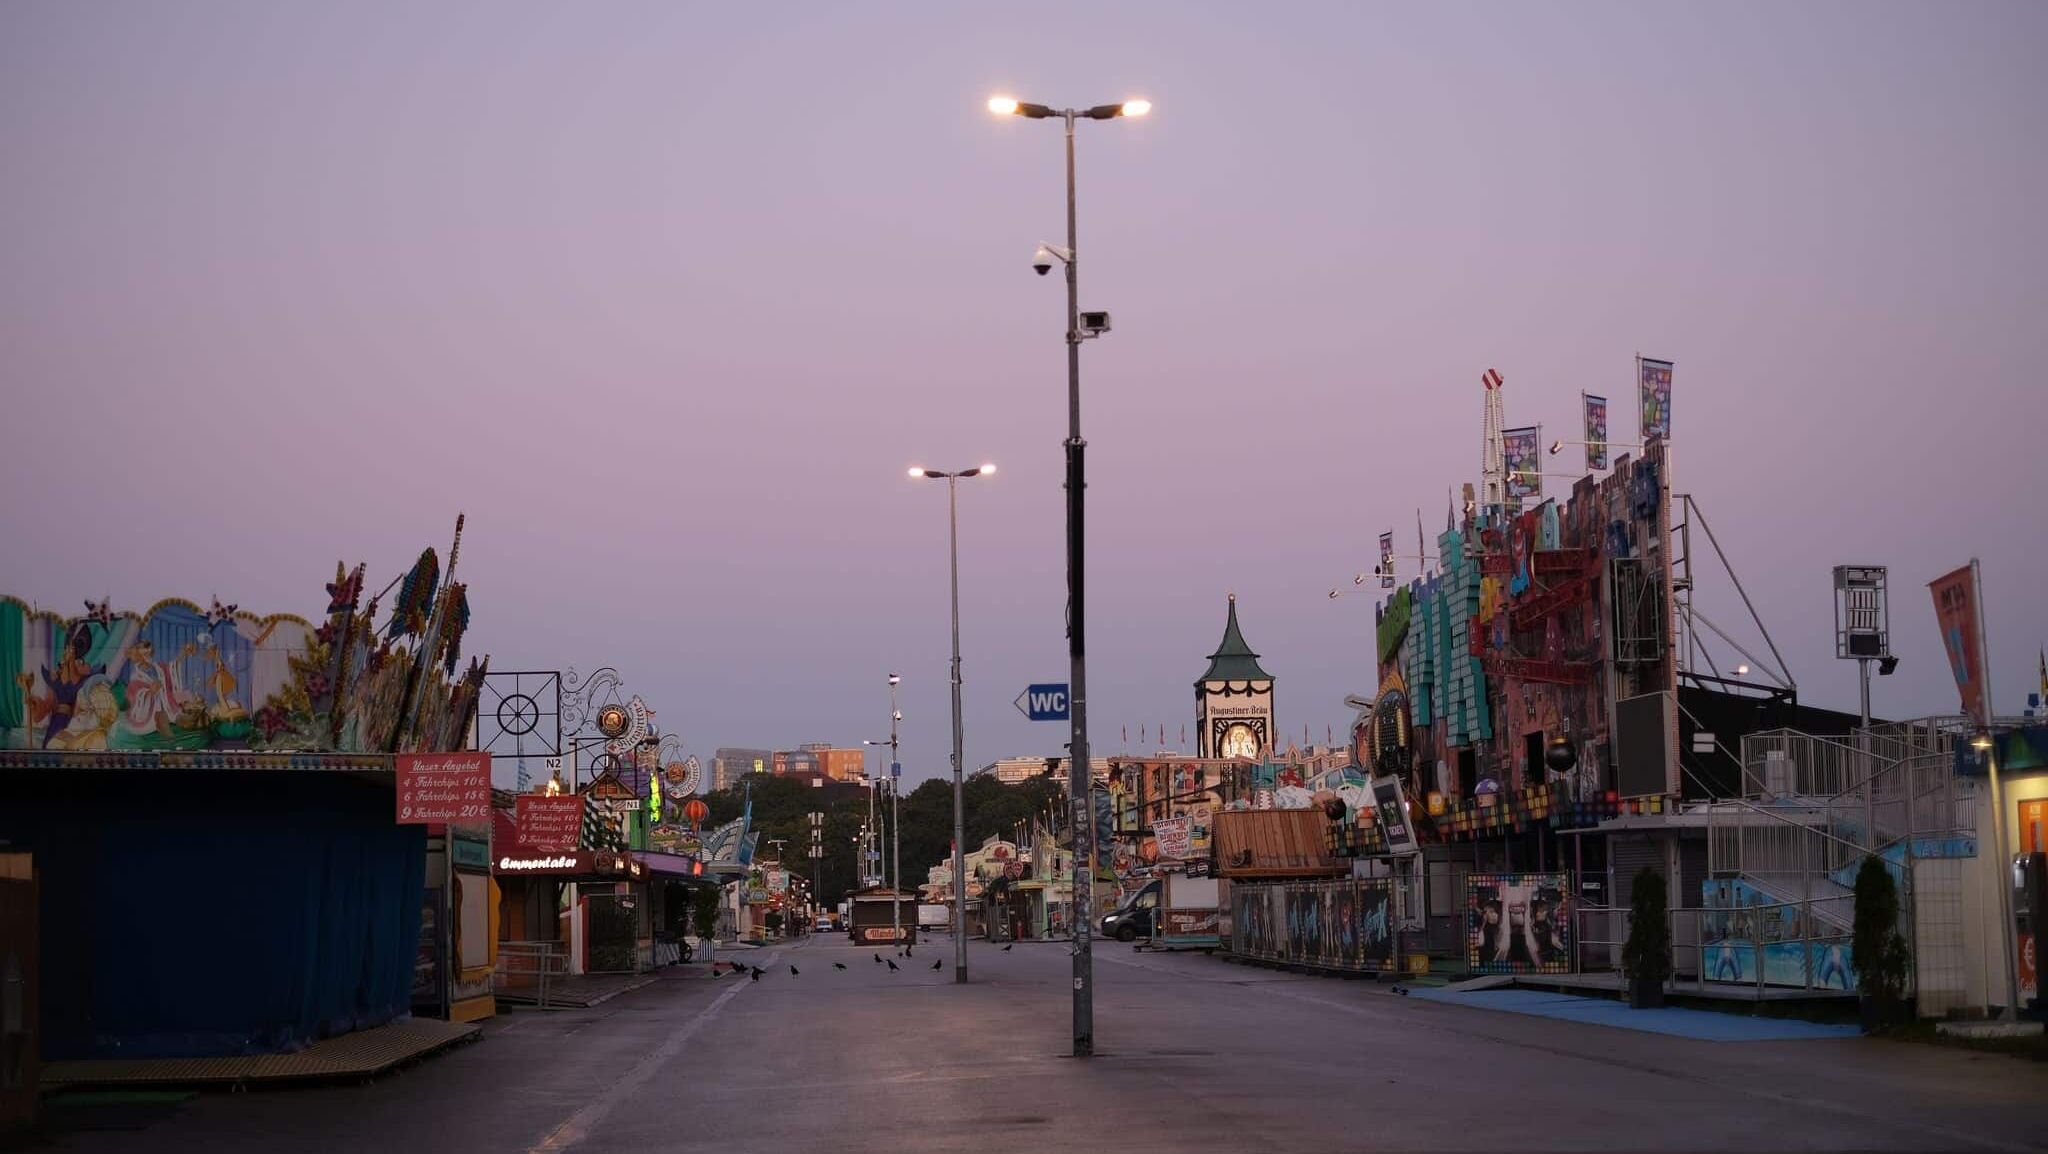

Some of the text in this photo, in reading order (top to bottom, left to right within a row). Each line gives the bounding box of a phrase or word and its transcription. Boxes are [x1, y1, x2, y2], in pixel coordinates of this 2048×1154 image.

[1030, 692, 1065, 713] WC
[412, 759, 480, 774] Unser Angebot
[546, 758, 561, 768] N2
[403, 792, 411, 802] 6
[401, 806, 412, 819] 9
